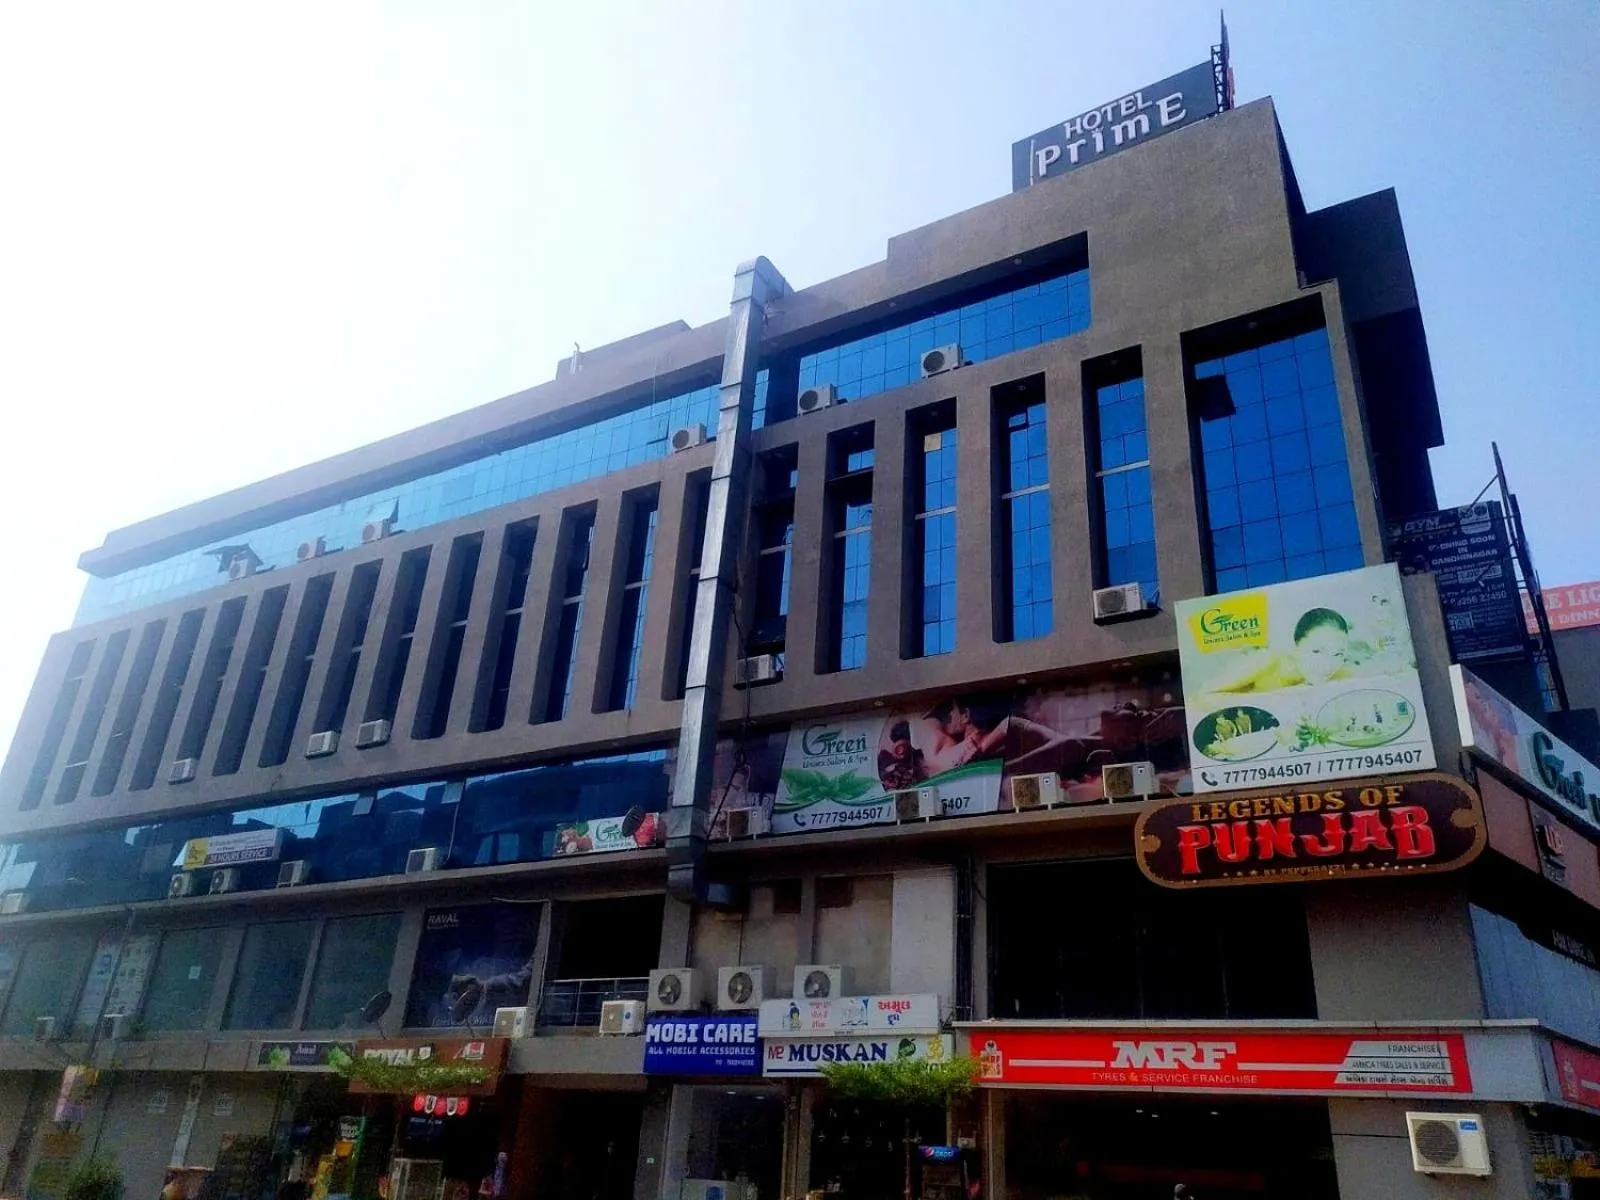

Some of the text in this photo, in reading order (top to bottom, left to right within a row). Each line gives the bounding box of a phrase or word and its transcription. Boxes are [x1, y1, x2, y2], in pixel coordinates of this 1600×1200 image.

[1063, 91, 1153, 140] HOTEL
[1200, 609, 1259, 635] Green
[801, 723, 868, 756] Green
[1223, 750, 1422, 784] 7777944507 / 7777945407
[1192, 785, 1405, 823] LEGENDS OF
[811, 807, 884, 825] 7777944507
[1178, 806, 1436, 876] PUNJAB
[240, 848, 268, 860] SERVICE
[428, 912, 459, 926] RAVAL
[646, 1023, 756, 1043] MOBI CARE
[648, 1045, 756, 1056] ALL MOBILE ACCESSORIES
[788, 1043, 888, 1063] MUSKAN
[1109, 1041, 1236, 1070] MRF
[1092, 1072, 1258, 1084] TYRES & SERVICE FRANCHISE
